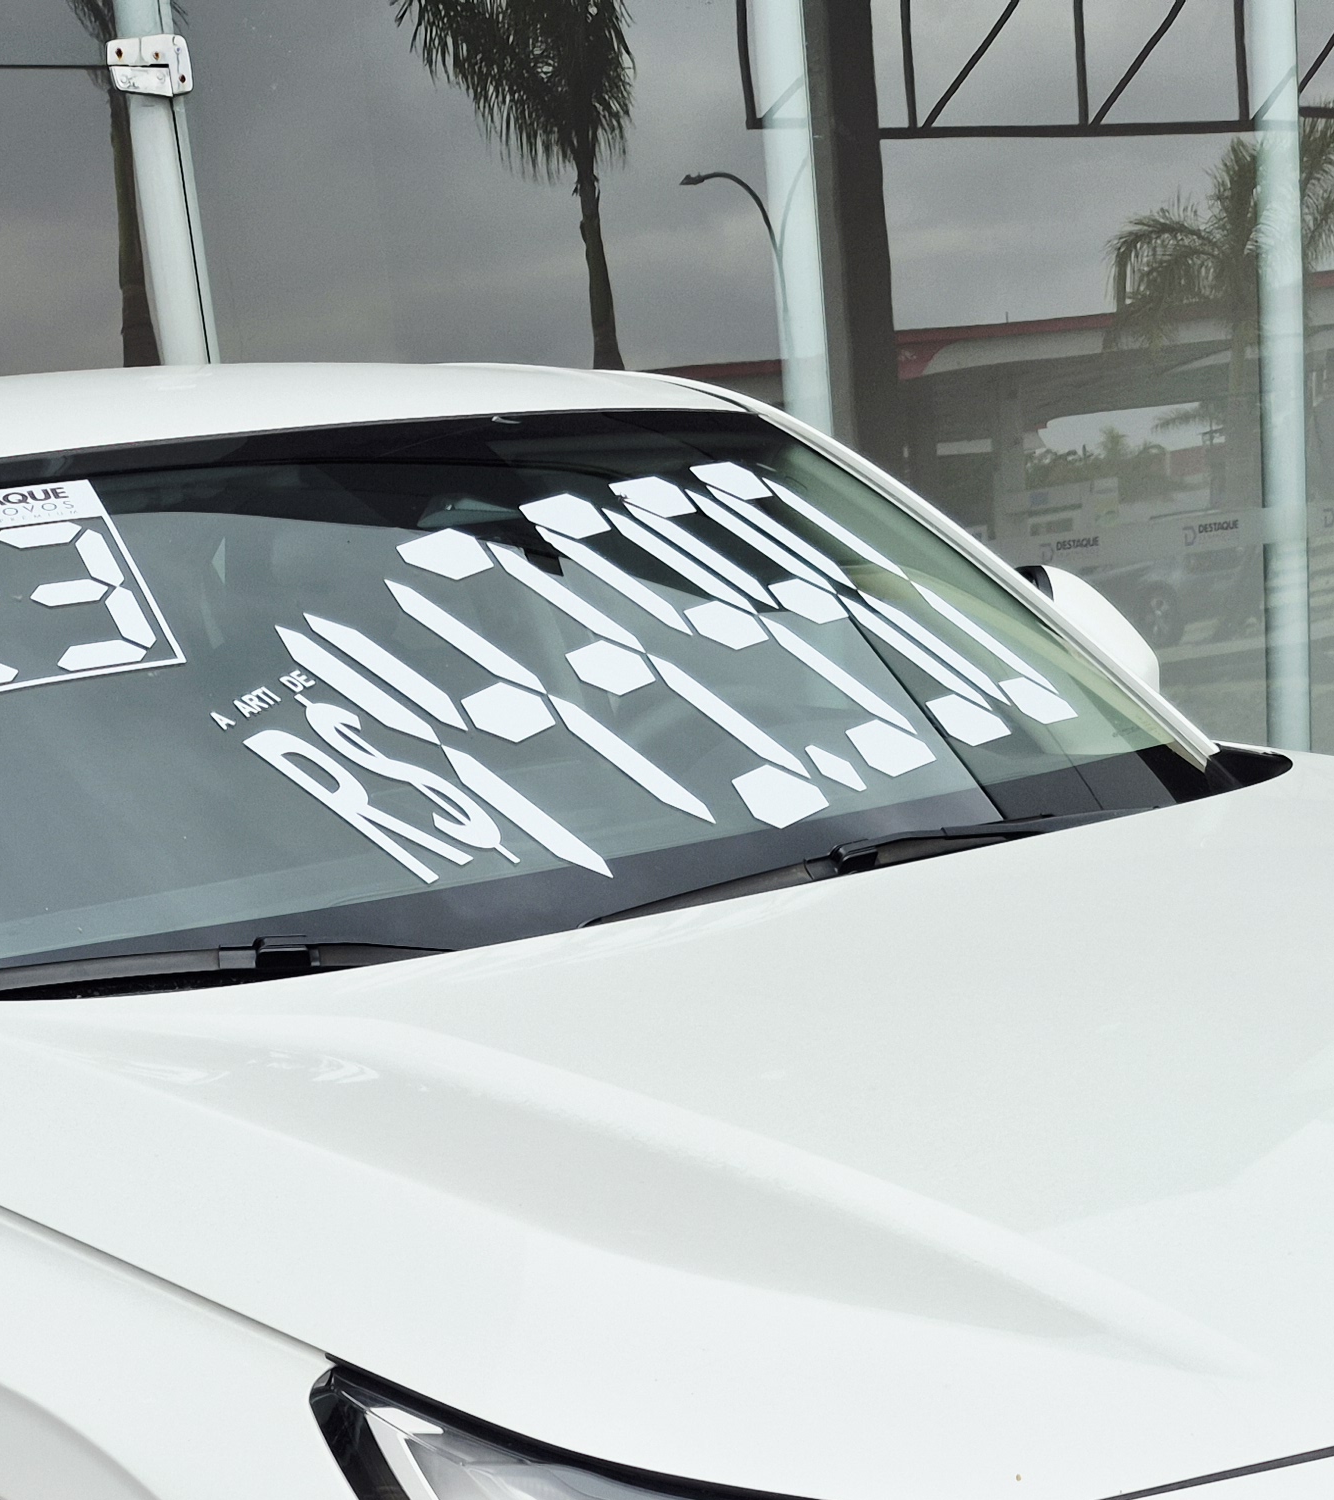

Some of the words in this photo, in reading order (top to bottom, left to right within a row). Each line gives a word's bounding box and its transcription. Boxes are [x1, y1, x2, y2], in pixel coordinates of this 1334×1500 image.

[1198, 518, 1240, 535] DESTAQUE
[1056, 535, 1099, 551] DESTAQUE
[210, 711, 236, 731] A
[279, 669, 317, 693] DE
